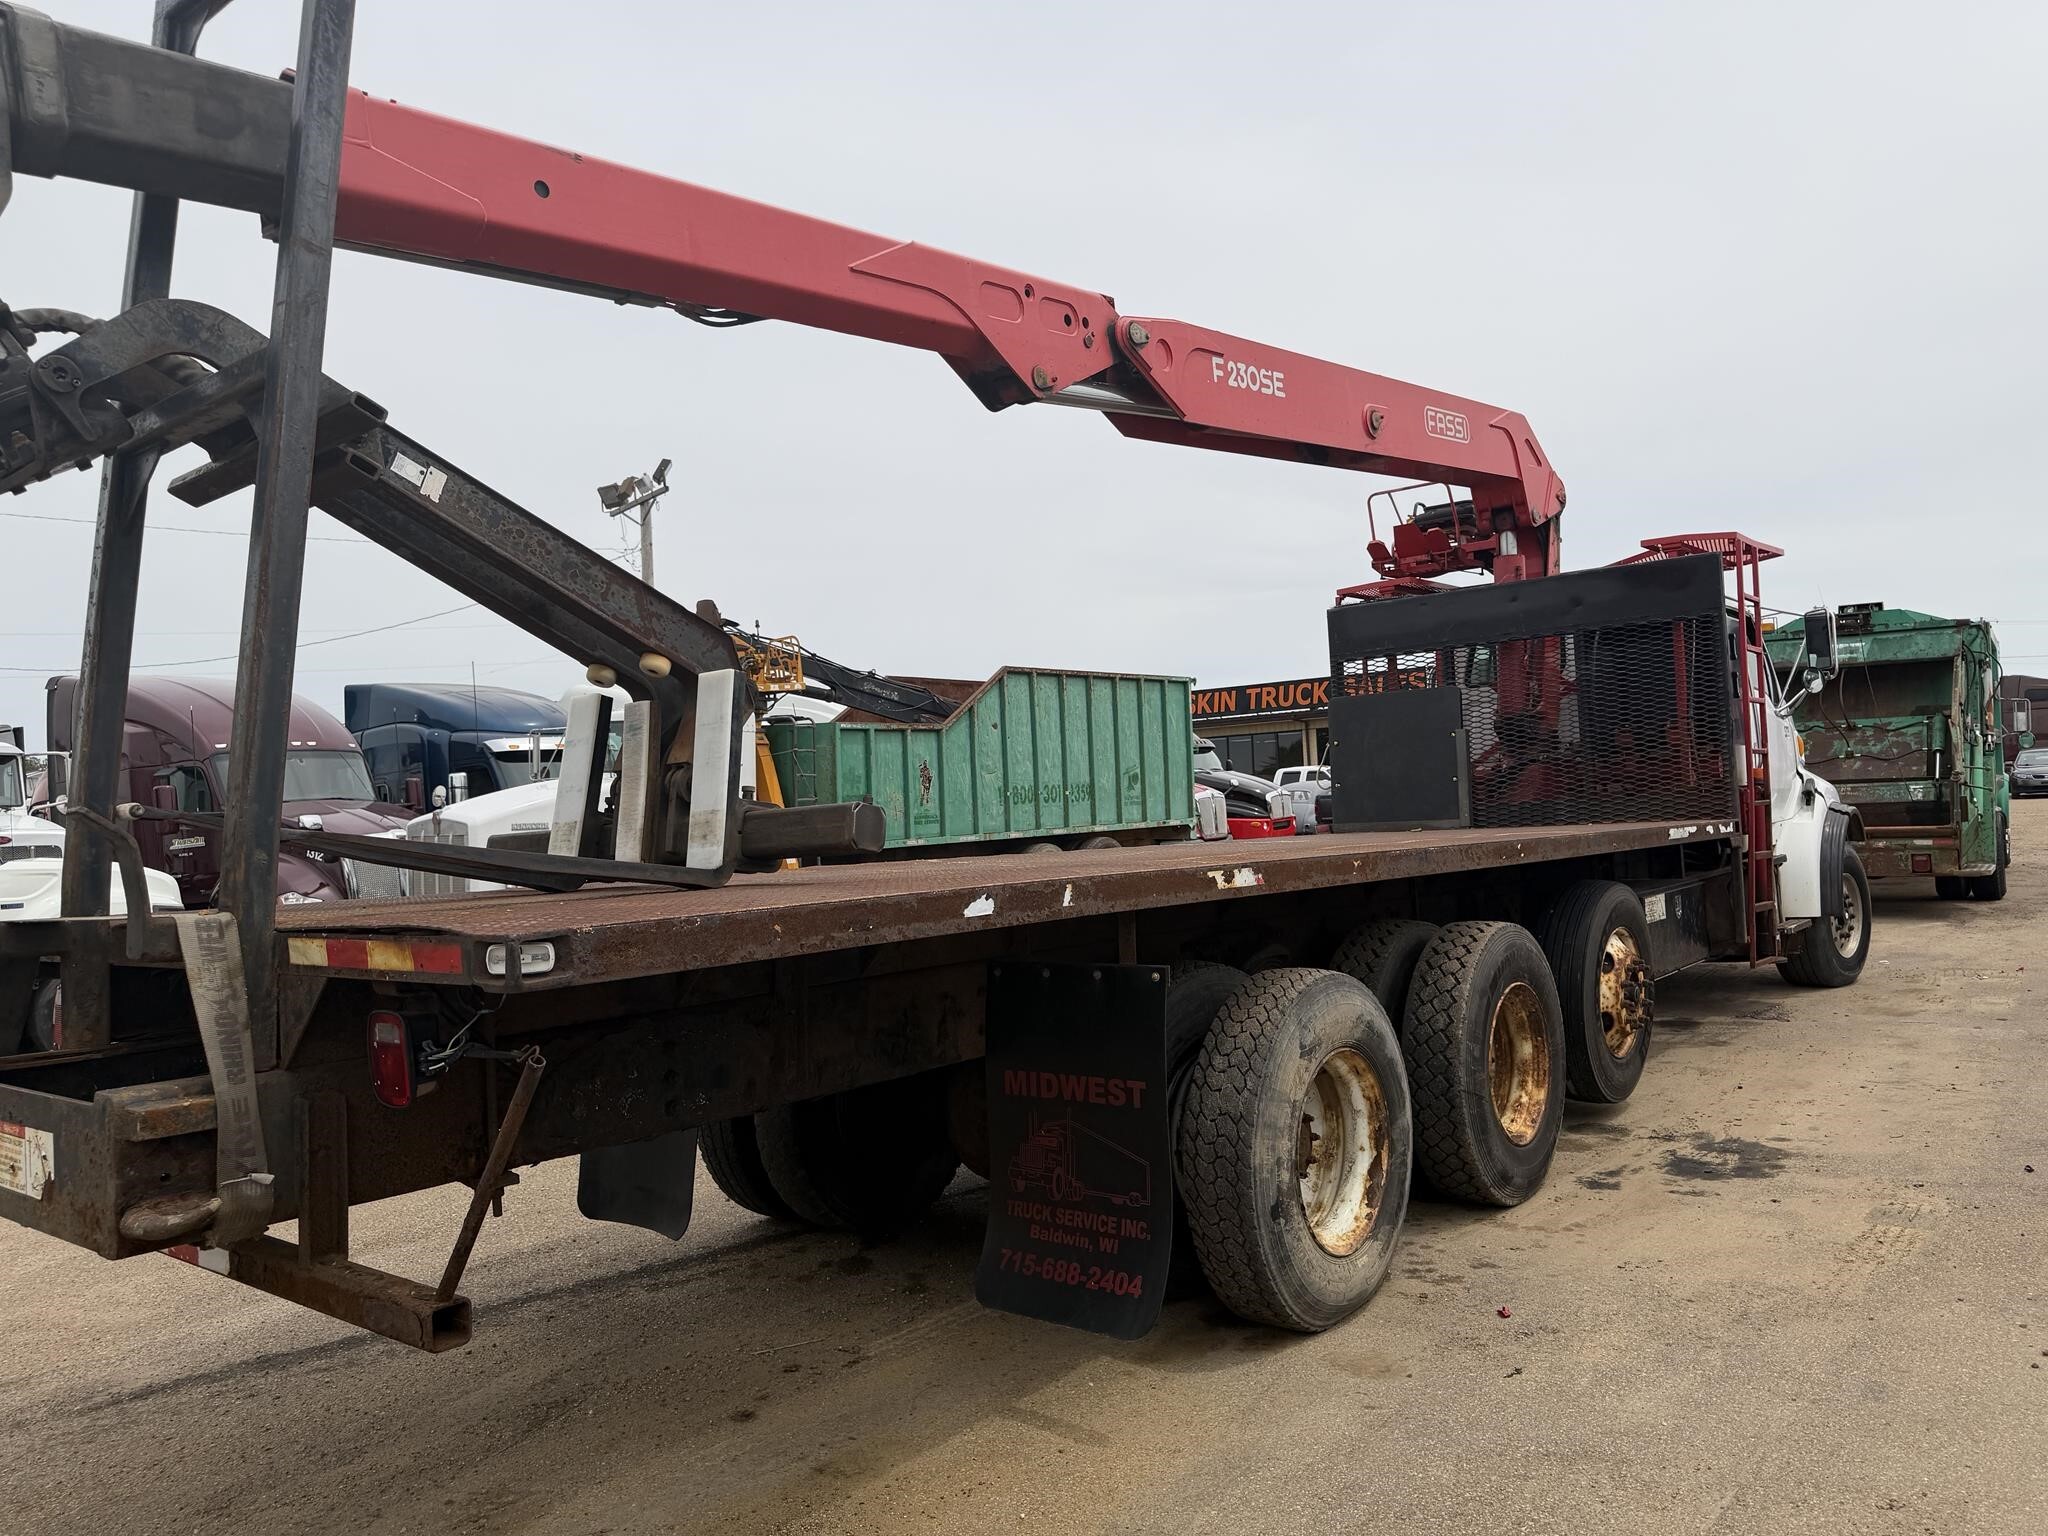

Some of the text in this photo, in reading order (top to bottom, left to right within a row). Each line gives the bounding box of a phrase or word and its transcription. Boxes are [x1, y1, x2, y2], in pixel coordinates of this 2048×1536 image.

[1212, 356, 1286, 398] F 230SE
[1427, 410, 1468, 440] FASSI
[1246, 680, 1330, 710] TRUCK
[1004, 1069, 1147, 1109] MIDWEST
[1007, 1199, 1052, 1222] TRUCK
[1055, 1207, 1118, 1234] SERVICE
[1030, 1224, 1119, 1255] Baldwin, WI
[1000, 1248, 1144, 1299] 715-688-2404
